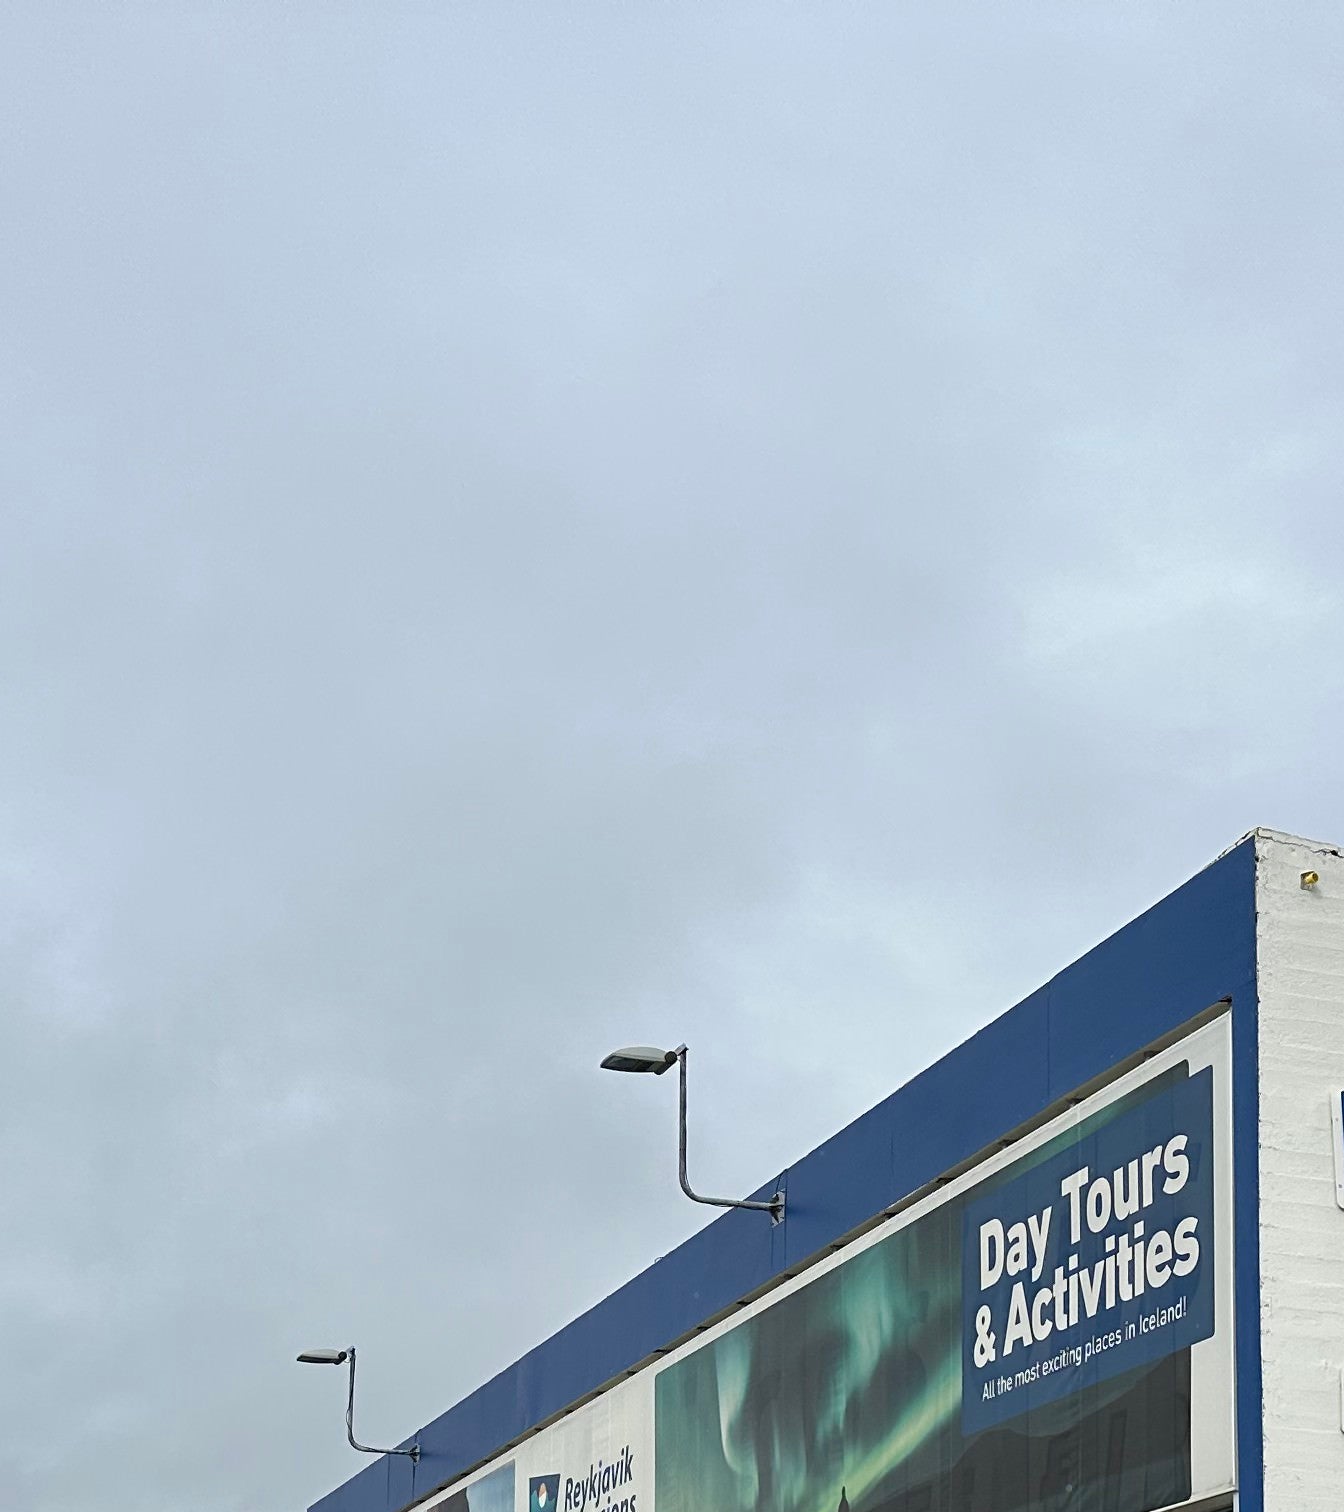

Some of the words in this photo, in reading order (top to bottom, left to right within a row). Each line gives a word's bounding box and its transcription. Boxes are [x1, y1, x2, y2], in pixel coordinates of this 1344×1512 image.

[980, 1205, 1053, 1291] Day
[1061, 1134, 1190, 1245] Tours
[973, 1304, 996, 1368] &
[1003, 1216, 1200, 1357] Activities
[982, 1382, 996, 1402] All
[997, 1375, 1013, 1396] the
[1015, 1363, 1040, 1388] most
[1042, 1347, 1082, 1376] exciting
[1085, 1327, 1122, 1363] places
[1125, 1320, 1136, 1341] in
[1139, 1296, 1188, 1336] Iceland!
